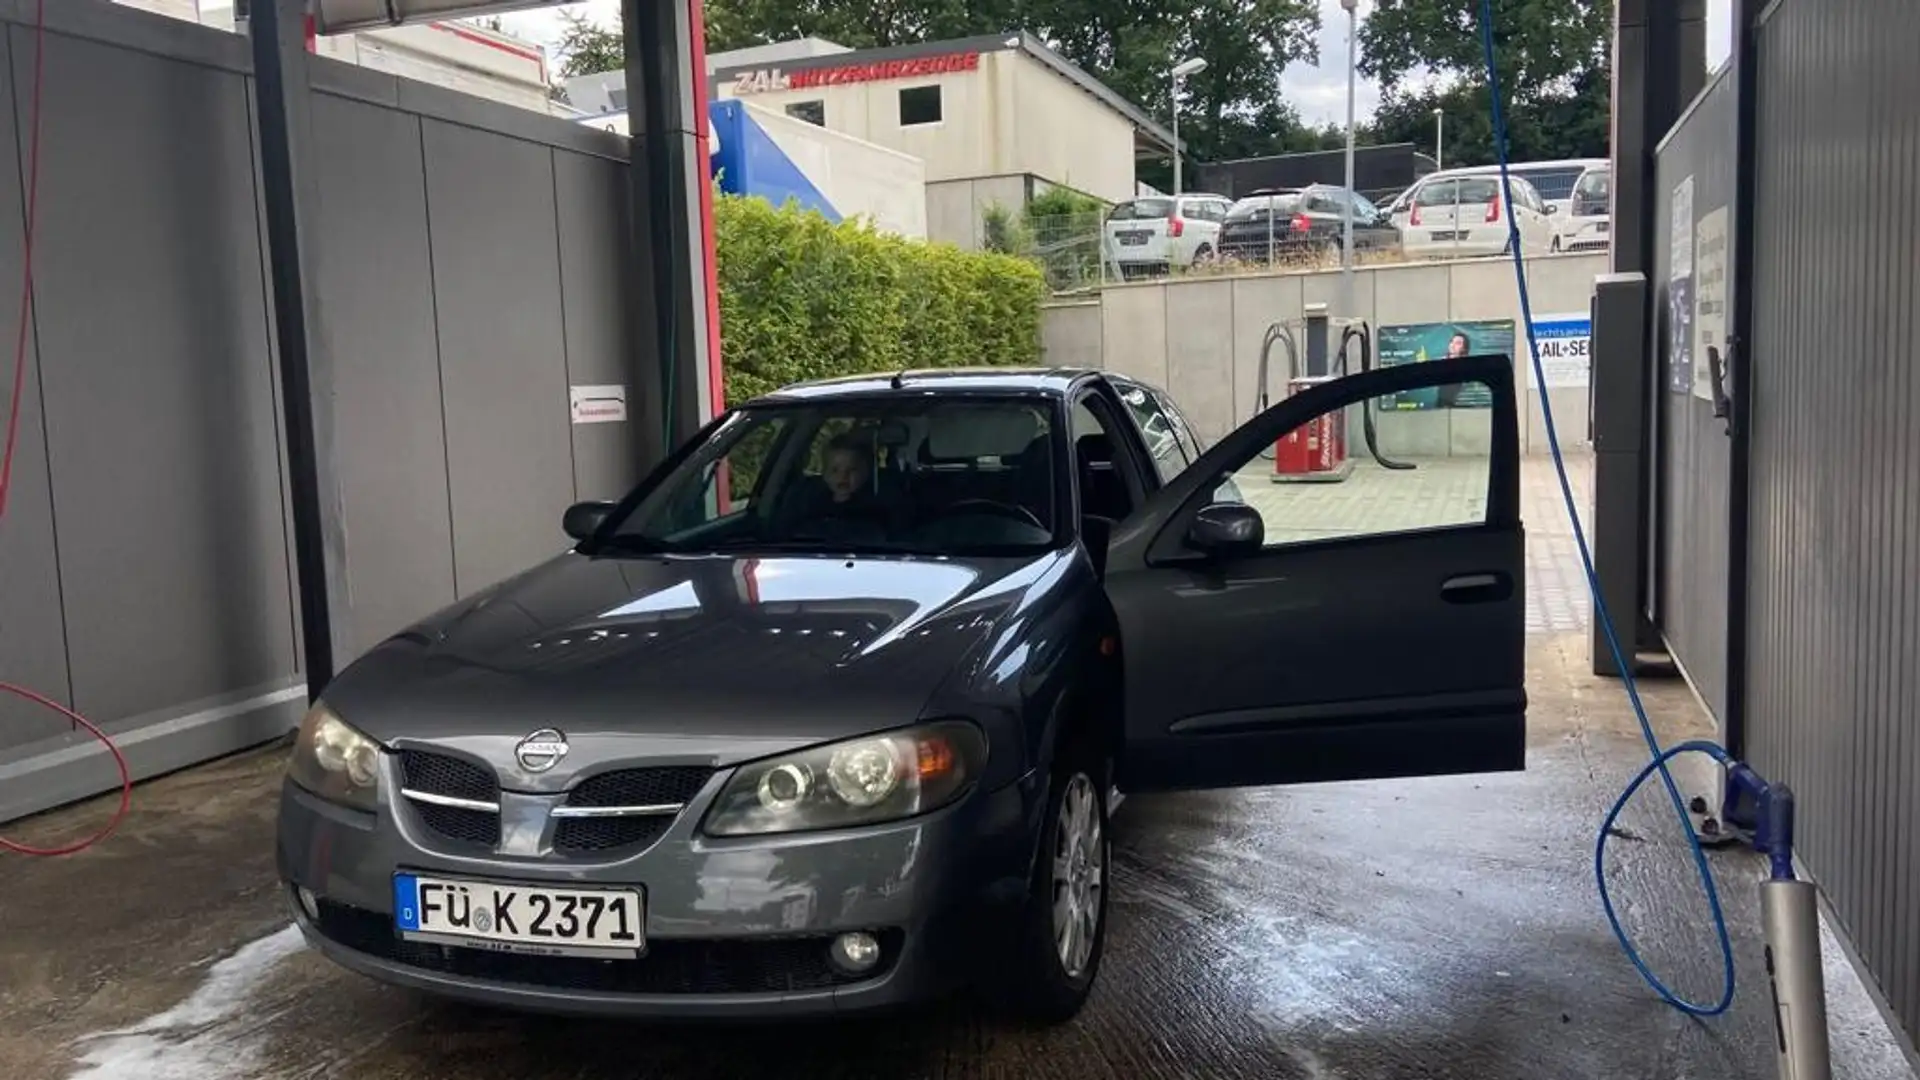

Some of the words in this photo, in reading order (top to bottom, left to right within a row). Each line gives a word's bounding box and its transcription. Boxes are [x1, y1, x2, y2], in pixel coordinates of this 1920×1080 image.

[404, 907, 412, 920] D
[419, 884, 470, 928] FÜ
[493, 890, 519, 934] K
[528, 893, 635, 940] 2371
